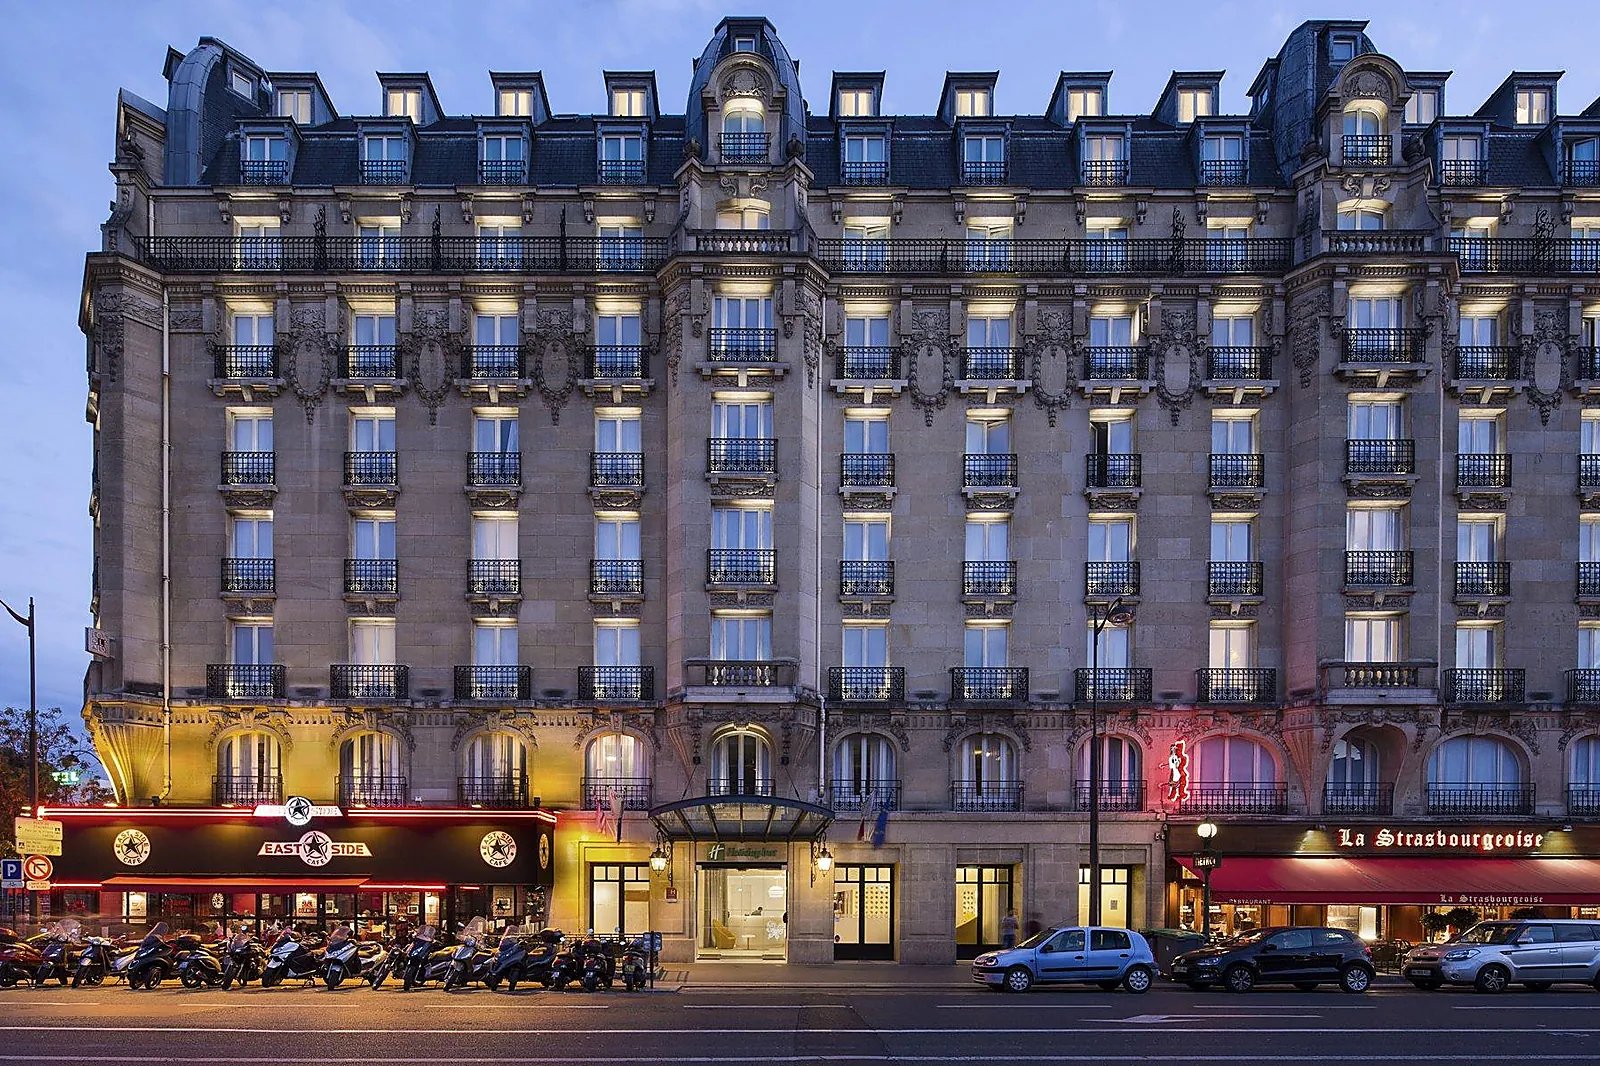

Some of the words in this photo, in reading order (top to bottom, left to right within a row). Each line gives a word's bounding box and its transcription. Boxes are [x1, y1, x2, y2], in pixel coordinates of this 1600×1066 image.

[116, 831, 130, 848] EAST
[135, 831, 150, 848] SIDE
[482, 832, 497, 850] EAST
[501, 832, 515, 850] SIDE
[1339, 828, 1365, 847] La
[1375, 828, 1544, 850] Strasbourgeoise
[264, 843, 303, 854] EAST
[331, 844, 364, 855] SIDE
[7, 863, 17, 877] P
[1440, 893, 1453, 903] La
[1459, 893, 1544, 904] Strasbourgeoise
